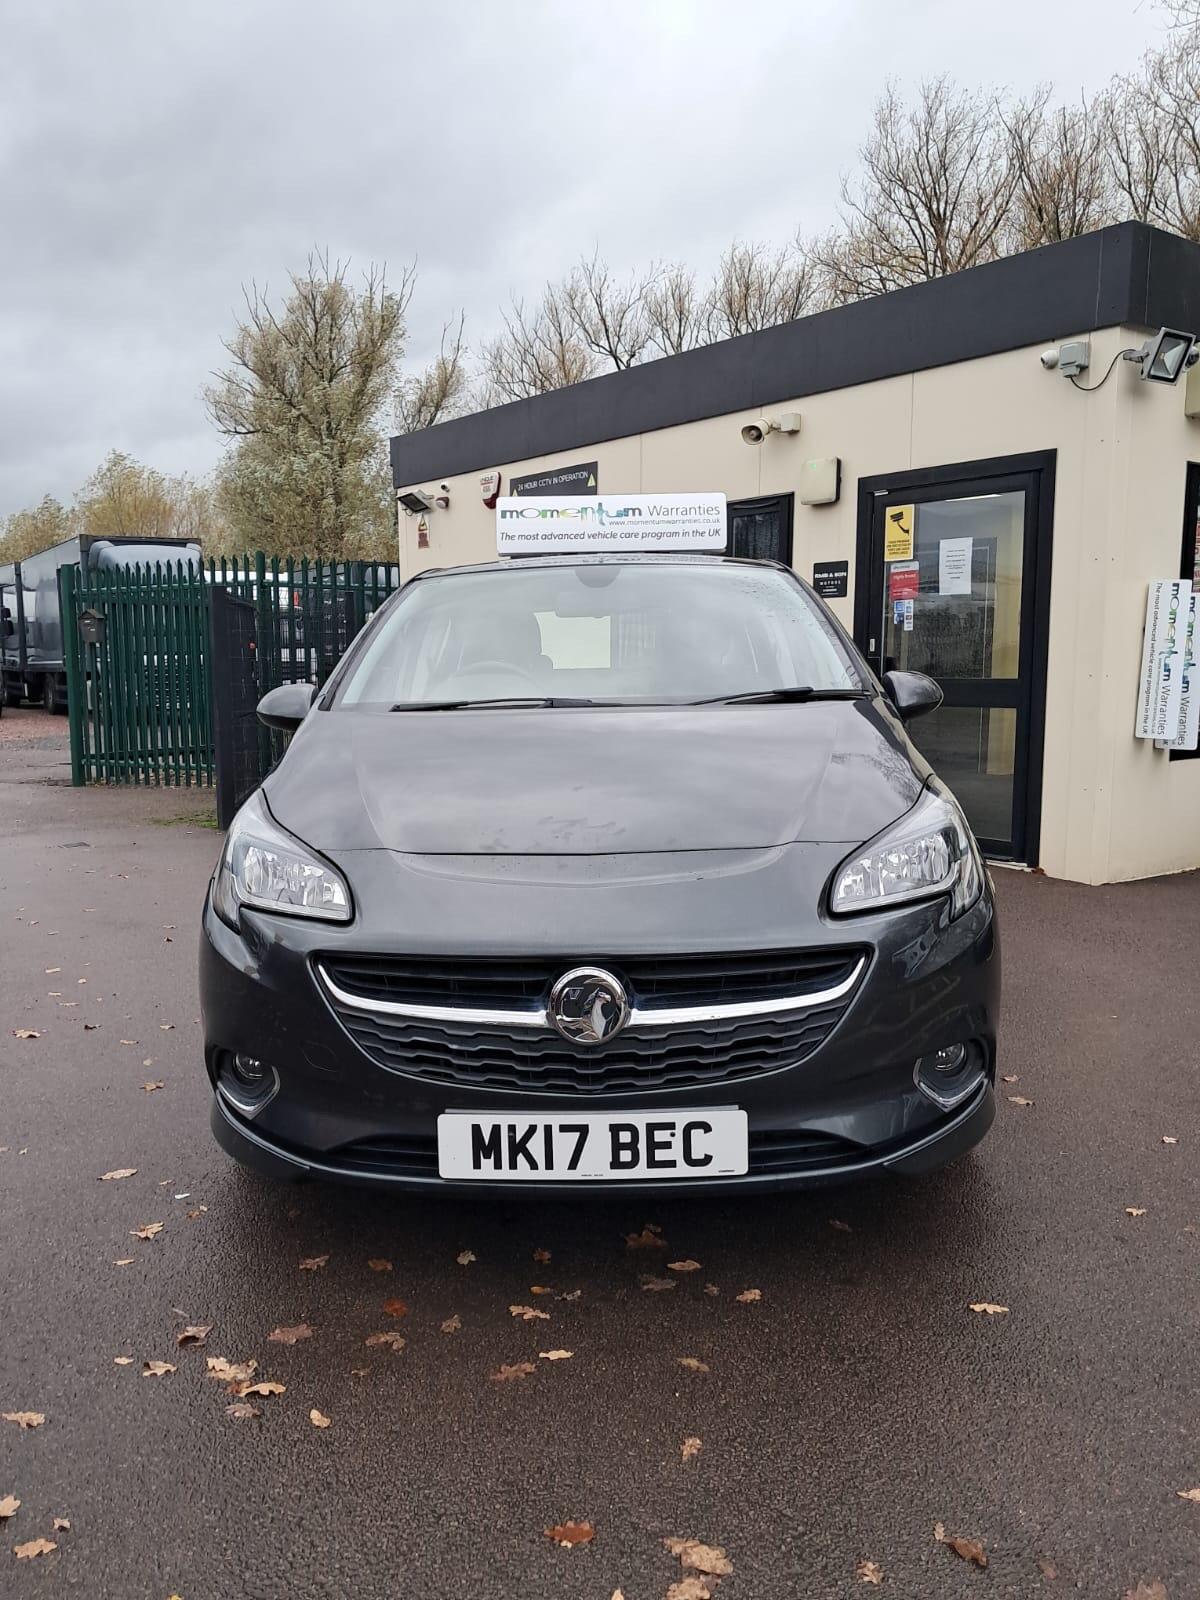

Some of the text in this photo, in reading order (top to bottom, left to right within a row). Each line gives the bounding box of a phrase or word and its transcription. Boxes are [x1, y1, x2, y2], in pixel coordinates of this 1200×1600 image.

[524, 480, 538, 490] HOUR
[538, 478, 552, 487] CCTV
[559, 471, 589, 483] OPERATION
[647, 504, 720, 517] Warranties
[501, 528, 721, 541] The most advanced vehicle care program in the UK
[1151, 610, 1159, 642] advanced
[1148, 642, 1156, 664] vehicle
[1144, 680, 1152, 707] program
[1158, 685, 1171, 735] Warranties
[1177, 696, 1191, 746] Warranties
[1142, 726, 1149, 734] UK
[471, 1121, 714, 1170] MK17 BEC
